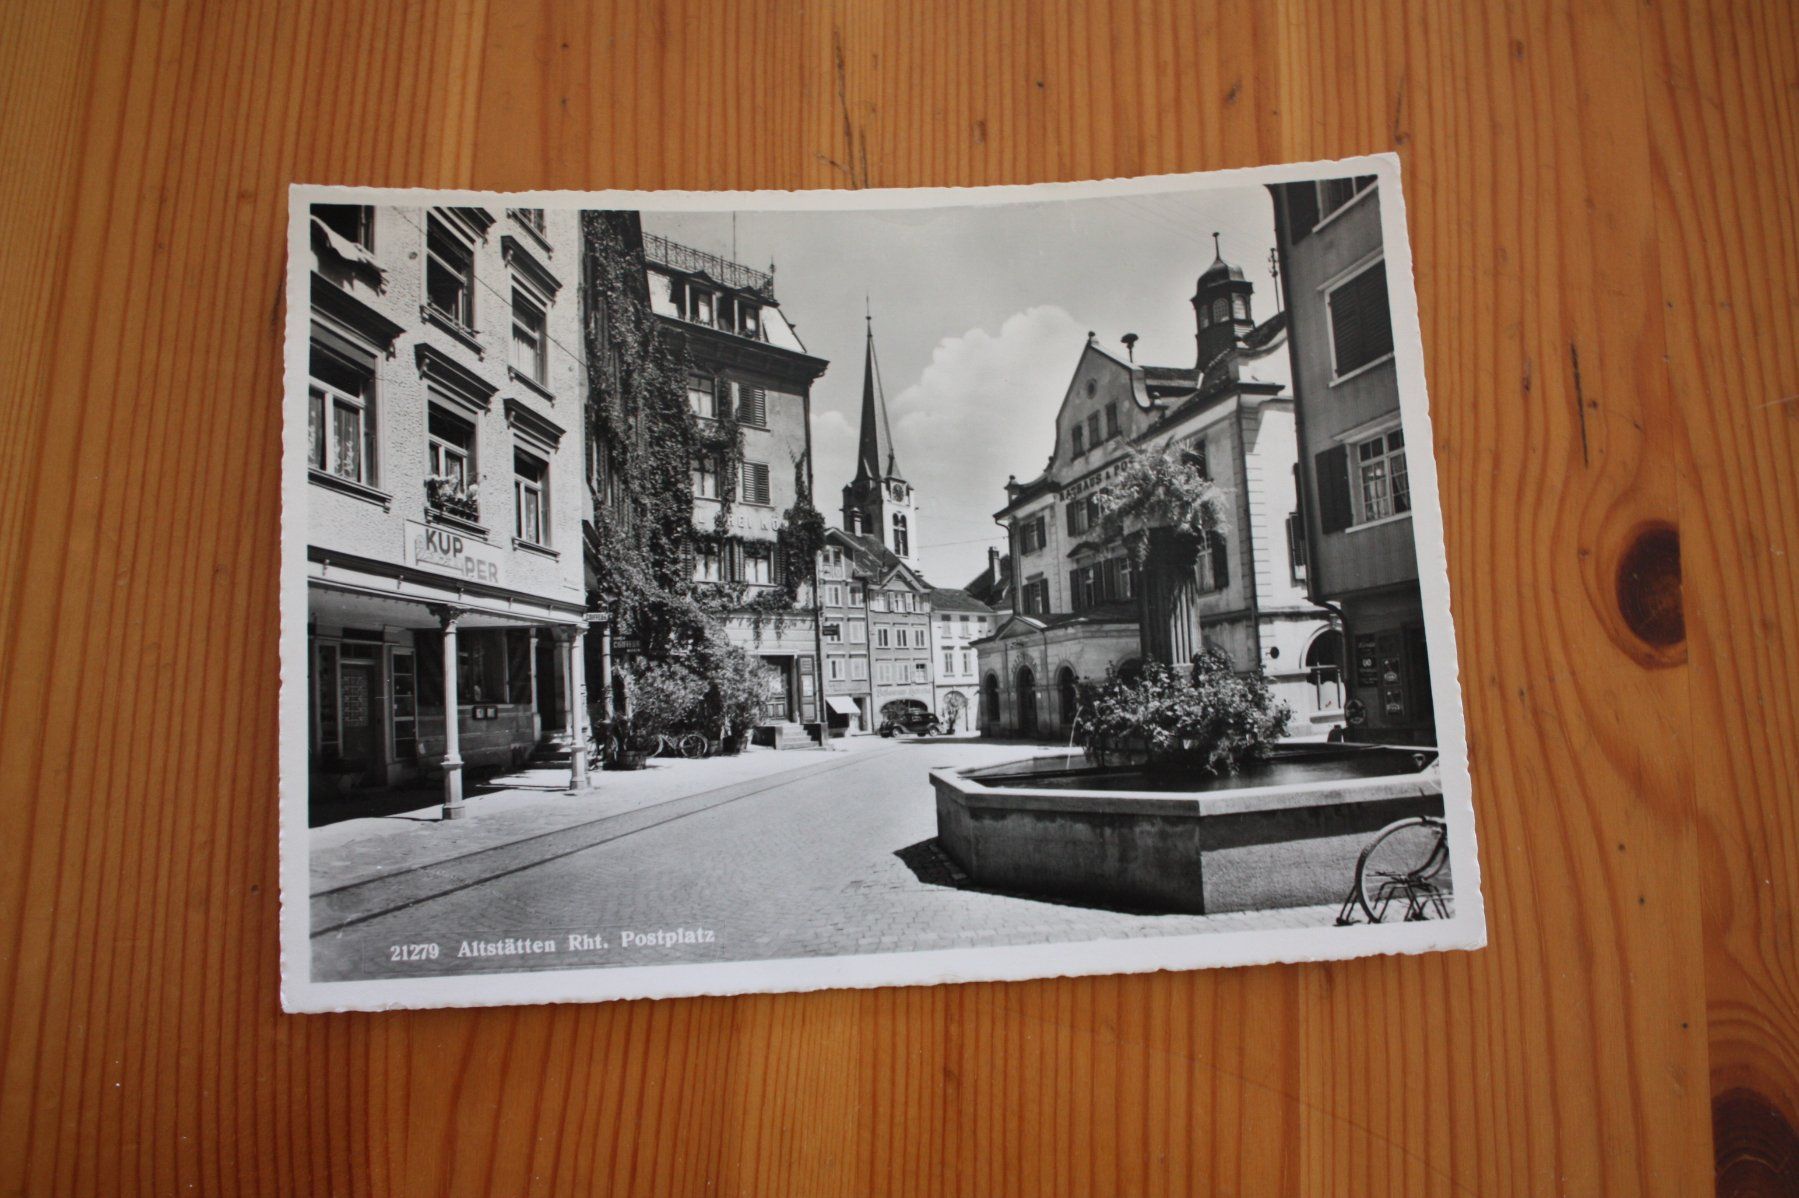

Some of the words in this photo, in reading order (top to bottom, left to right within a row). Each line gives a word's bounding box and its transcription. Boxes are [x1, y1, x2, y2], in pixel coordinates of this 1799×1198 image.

[426, 528, 464, 558] KUP
[464, 555, 498, 584] PER
[391, 942, 439, 962] 21279
[457, 938, 556, 958] Altstätten
[568, 933, 608, 951] Rht.
[621, 927, 715, 948] Postplatz
